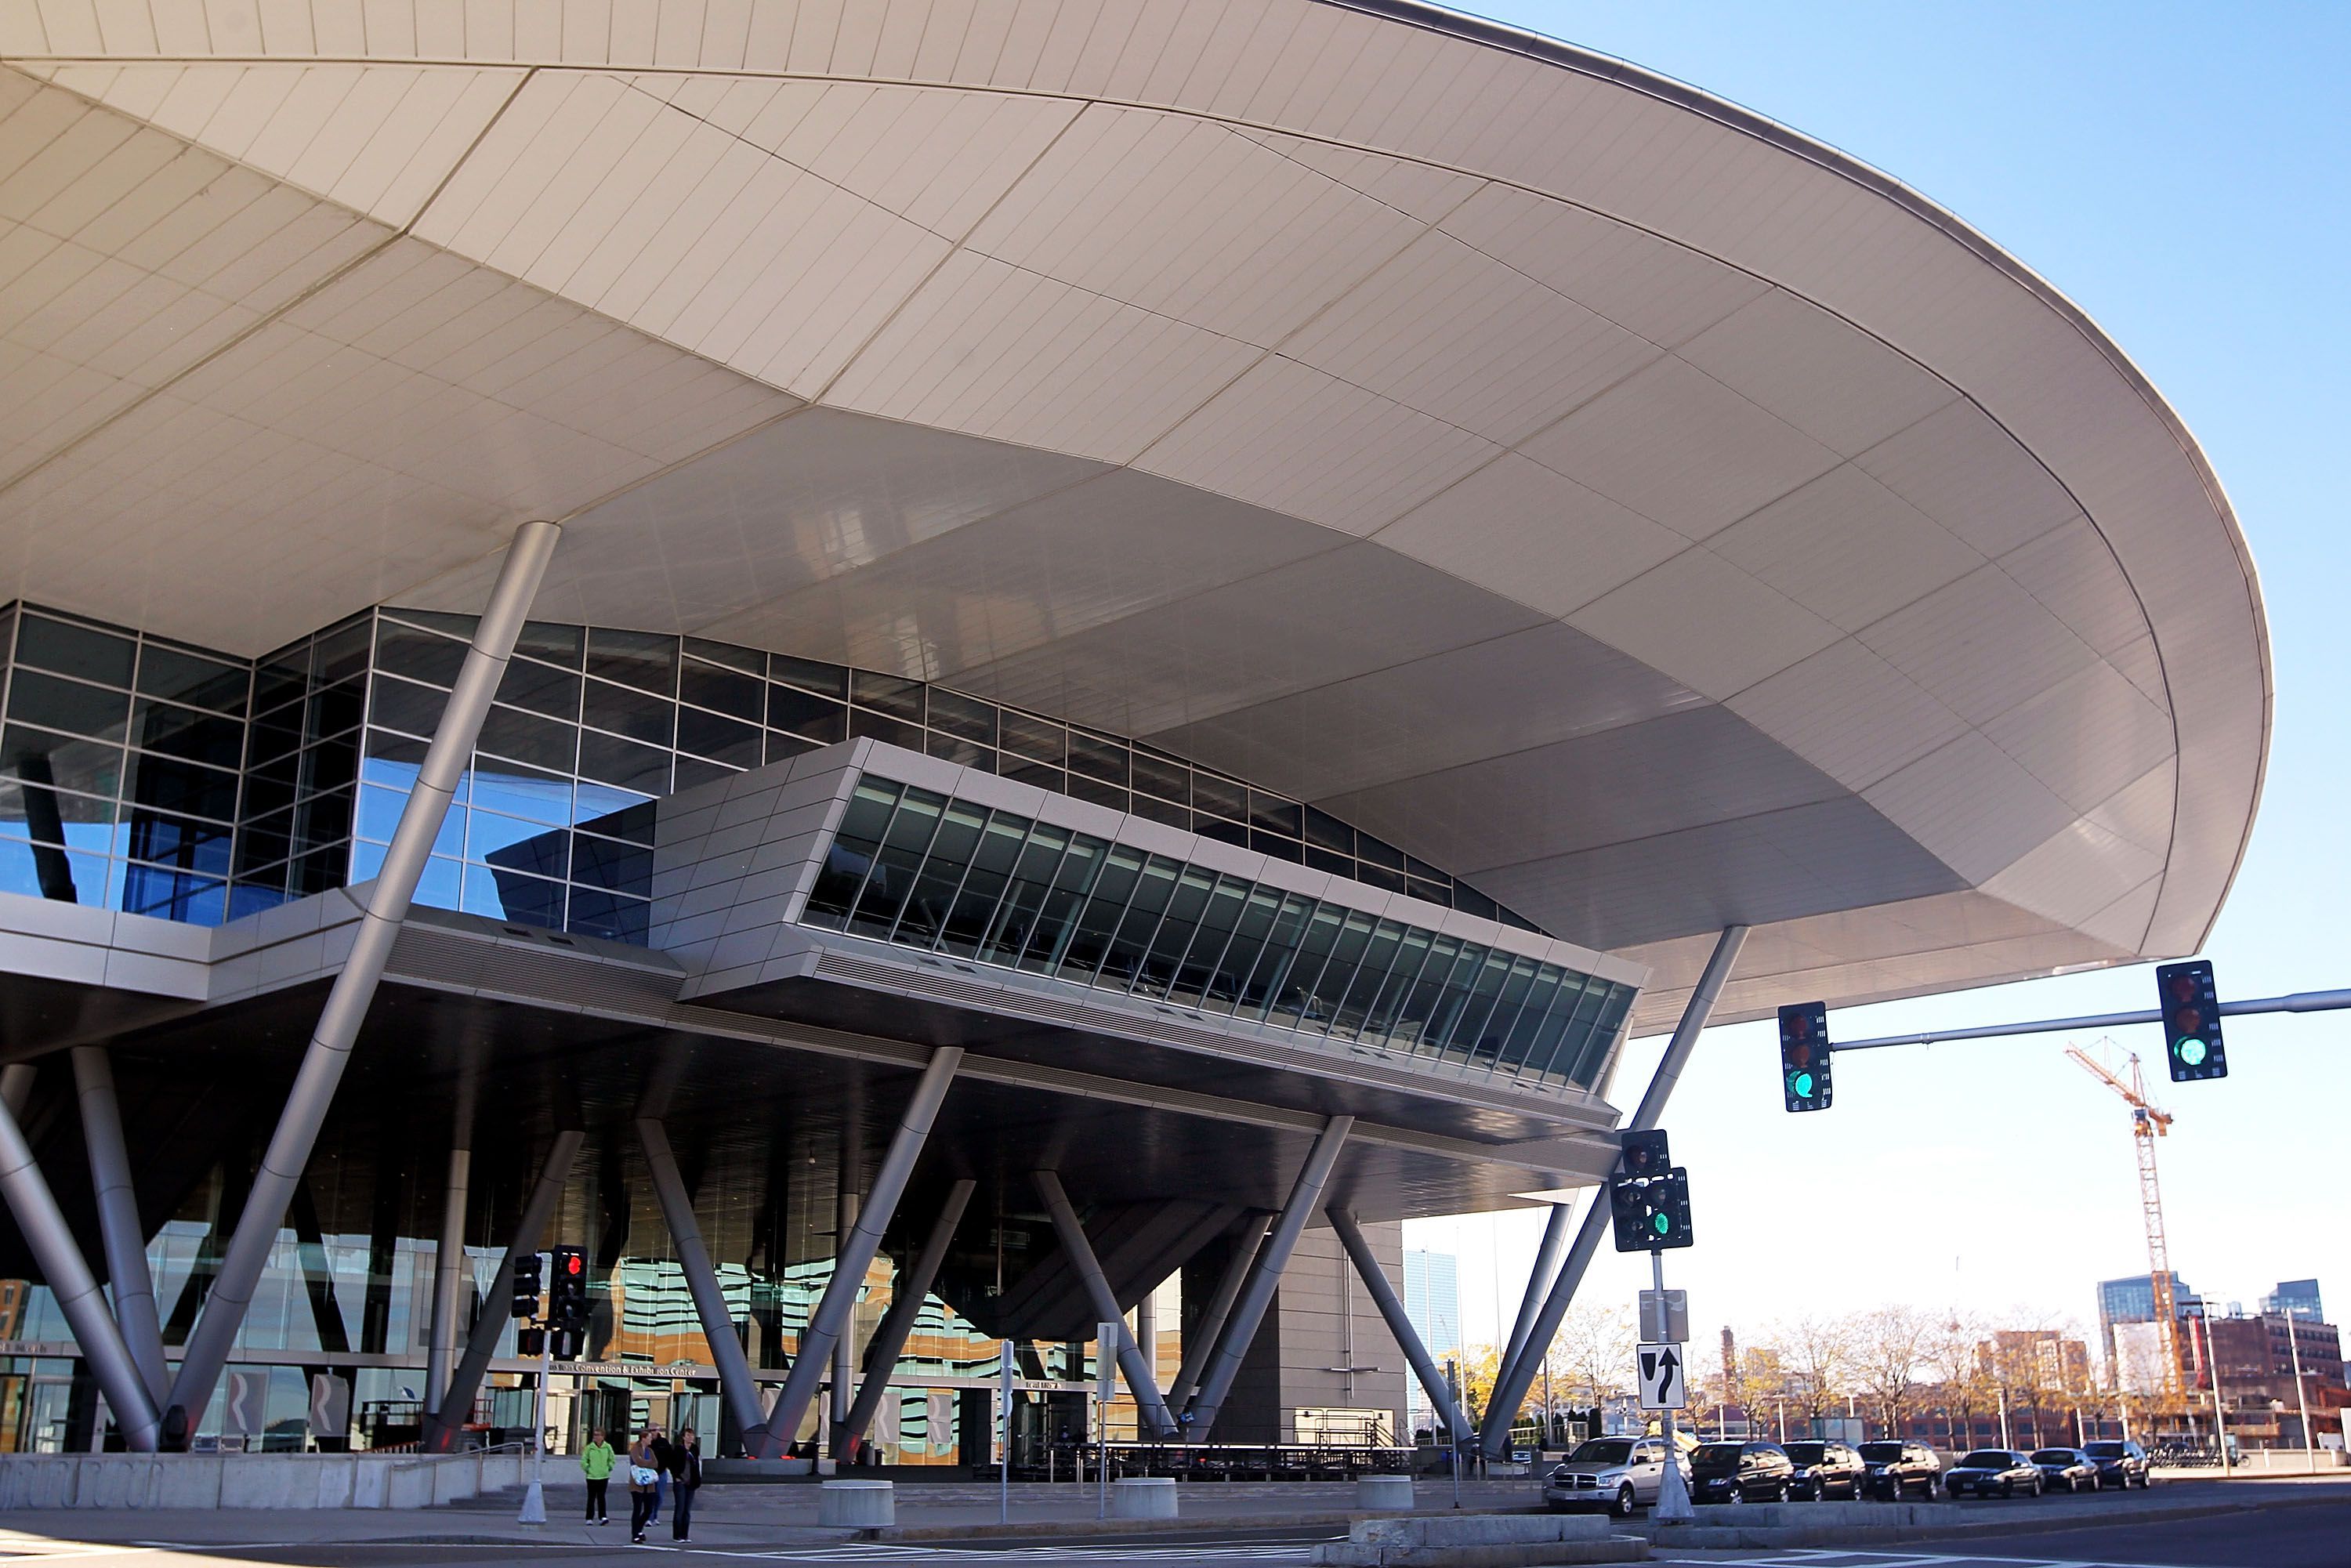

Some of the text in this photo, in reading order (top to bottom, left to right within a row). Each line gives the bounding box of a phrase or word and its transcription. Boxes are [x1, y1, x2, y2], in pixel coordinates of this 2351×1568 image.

[575, 1363, 621, 1374] Convention
[622, 1365, 629, 1374] &
[670, 1367, 696, 1376] Center
